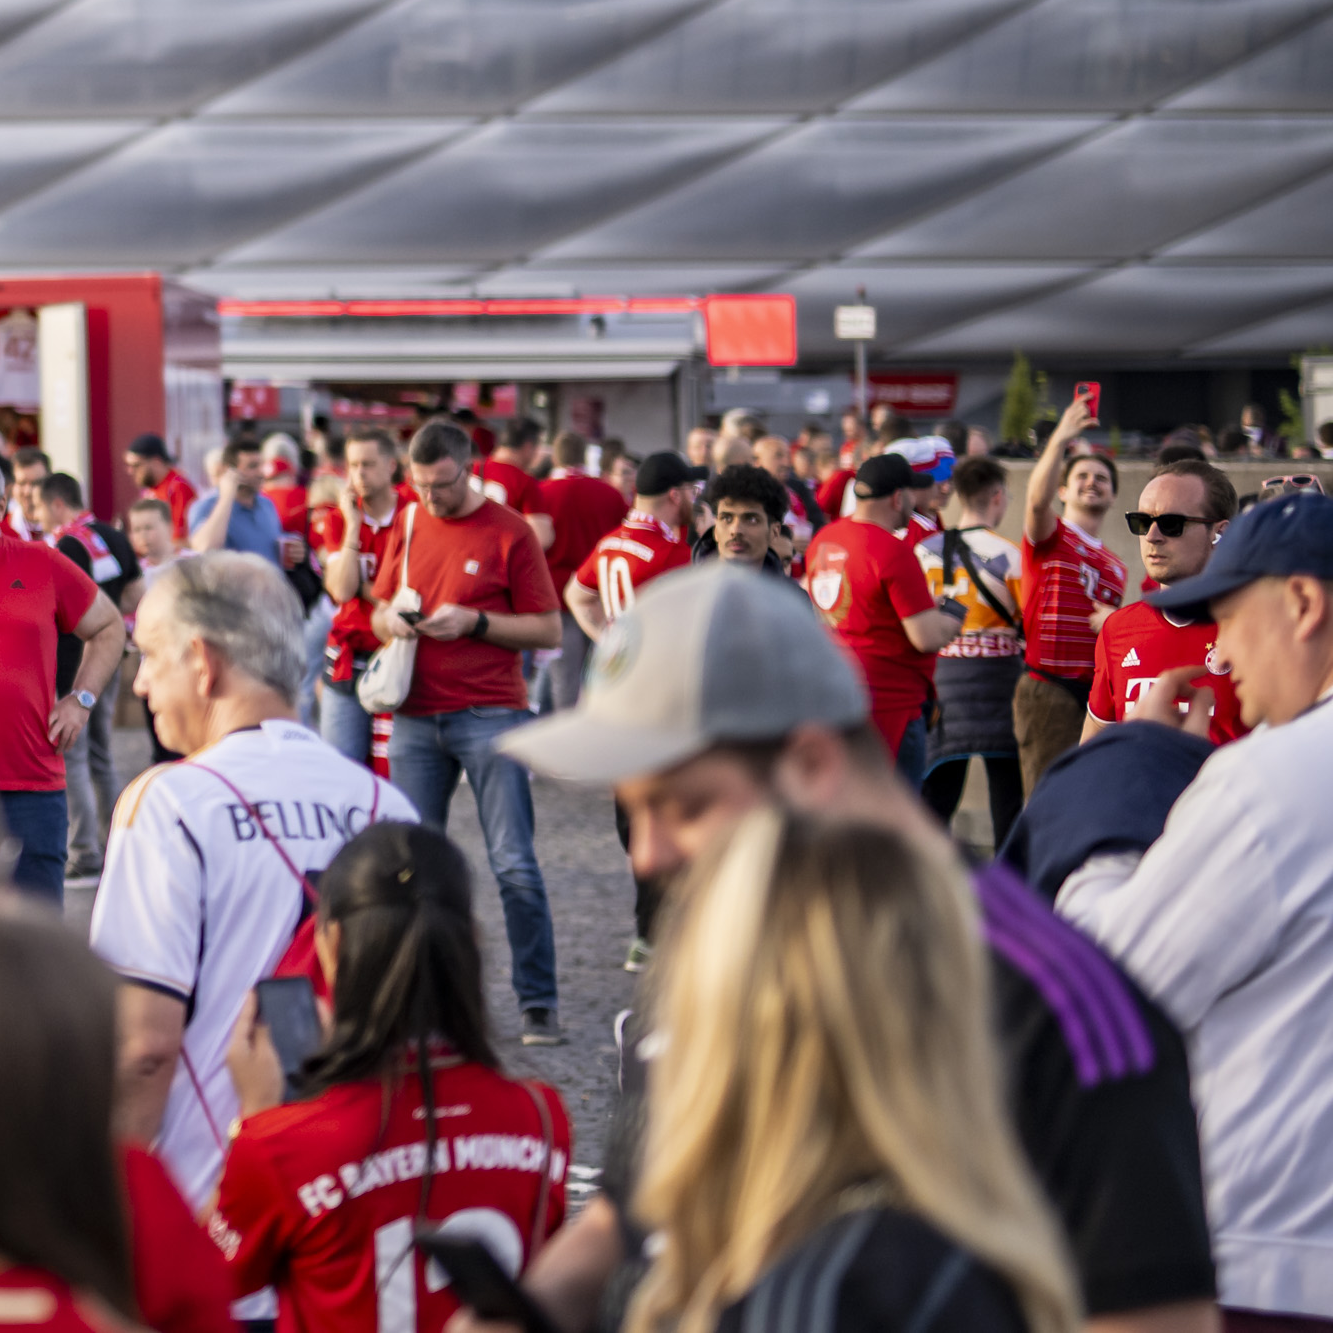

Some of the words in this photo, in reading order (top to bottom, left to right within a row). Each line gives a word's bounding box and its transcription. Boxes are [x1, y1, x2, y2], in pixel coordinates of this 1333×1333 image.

[226, 801, 366, 841] BELLING
[297, 1174, 342, 1217] FC
[454, 1133, 567, 1185] MÜNCHN
